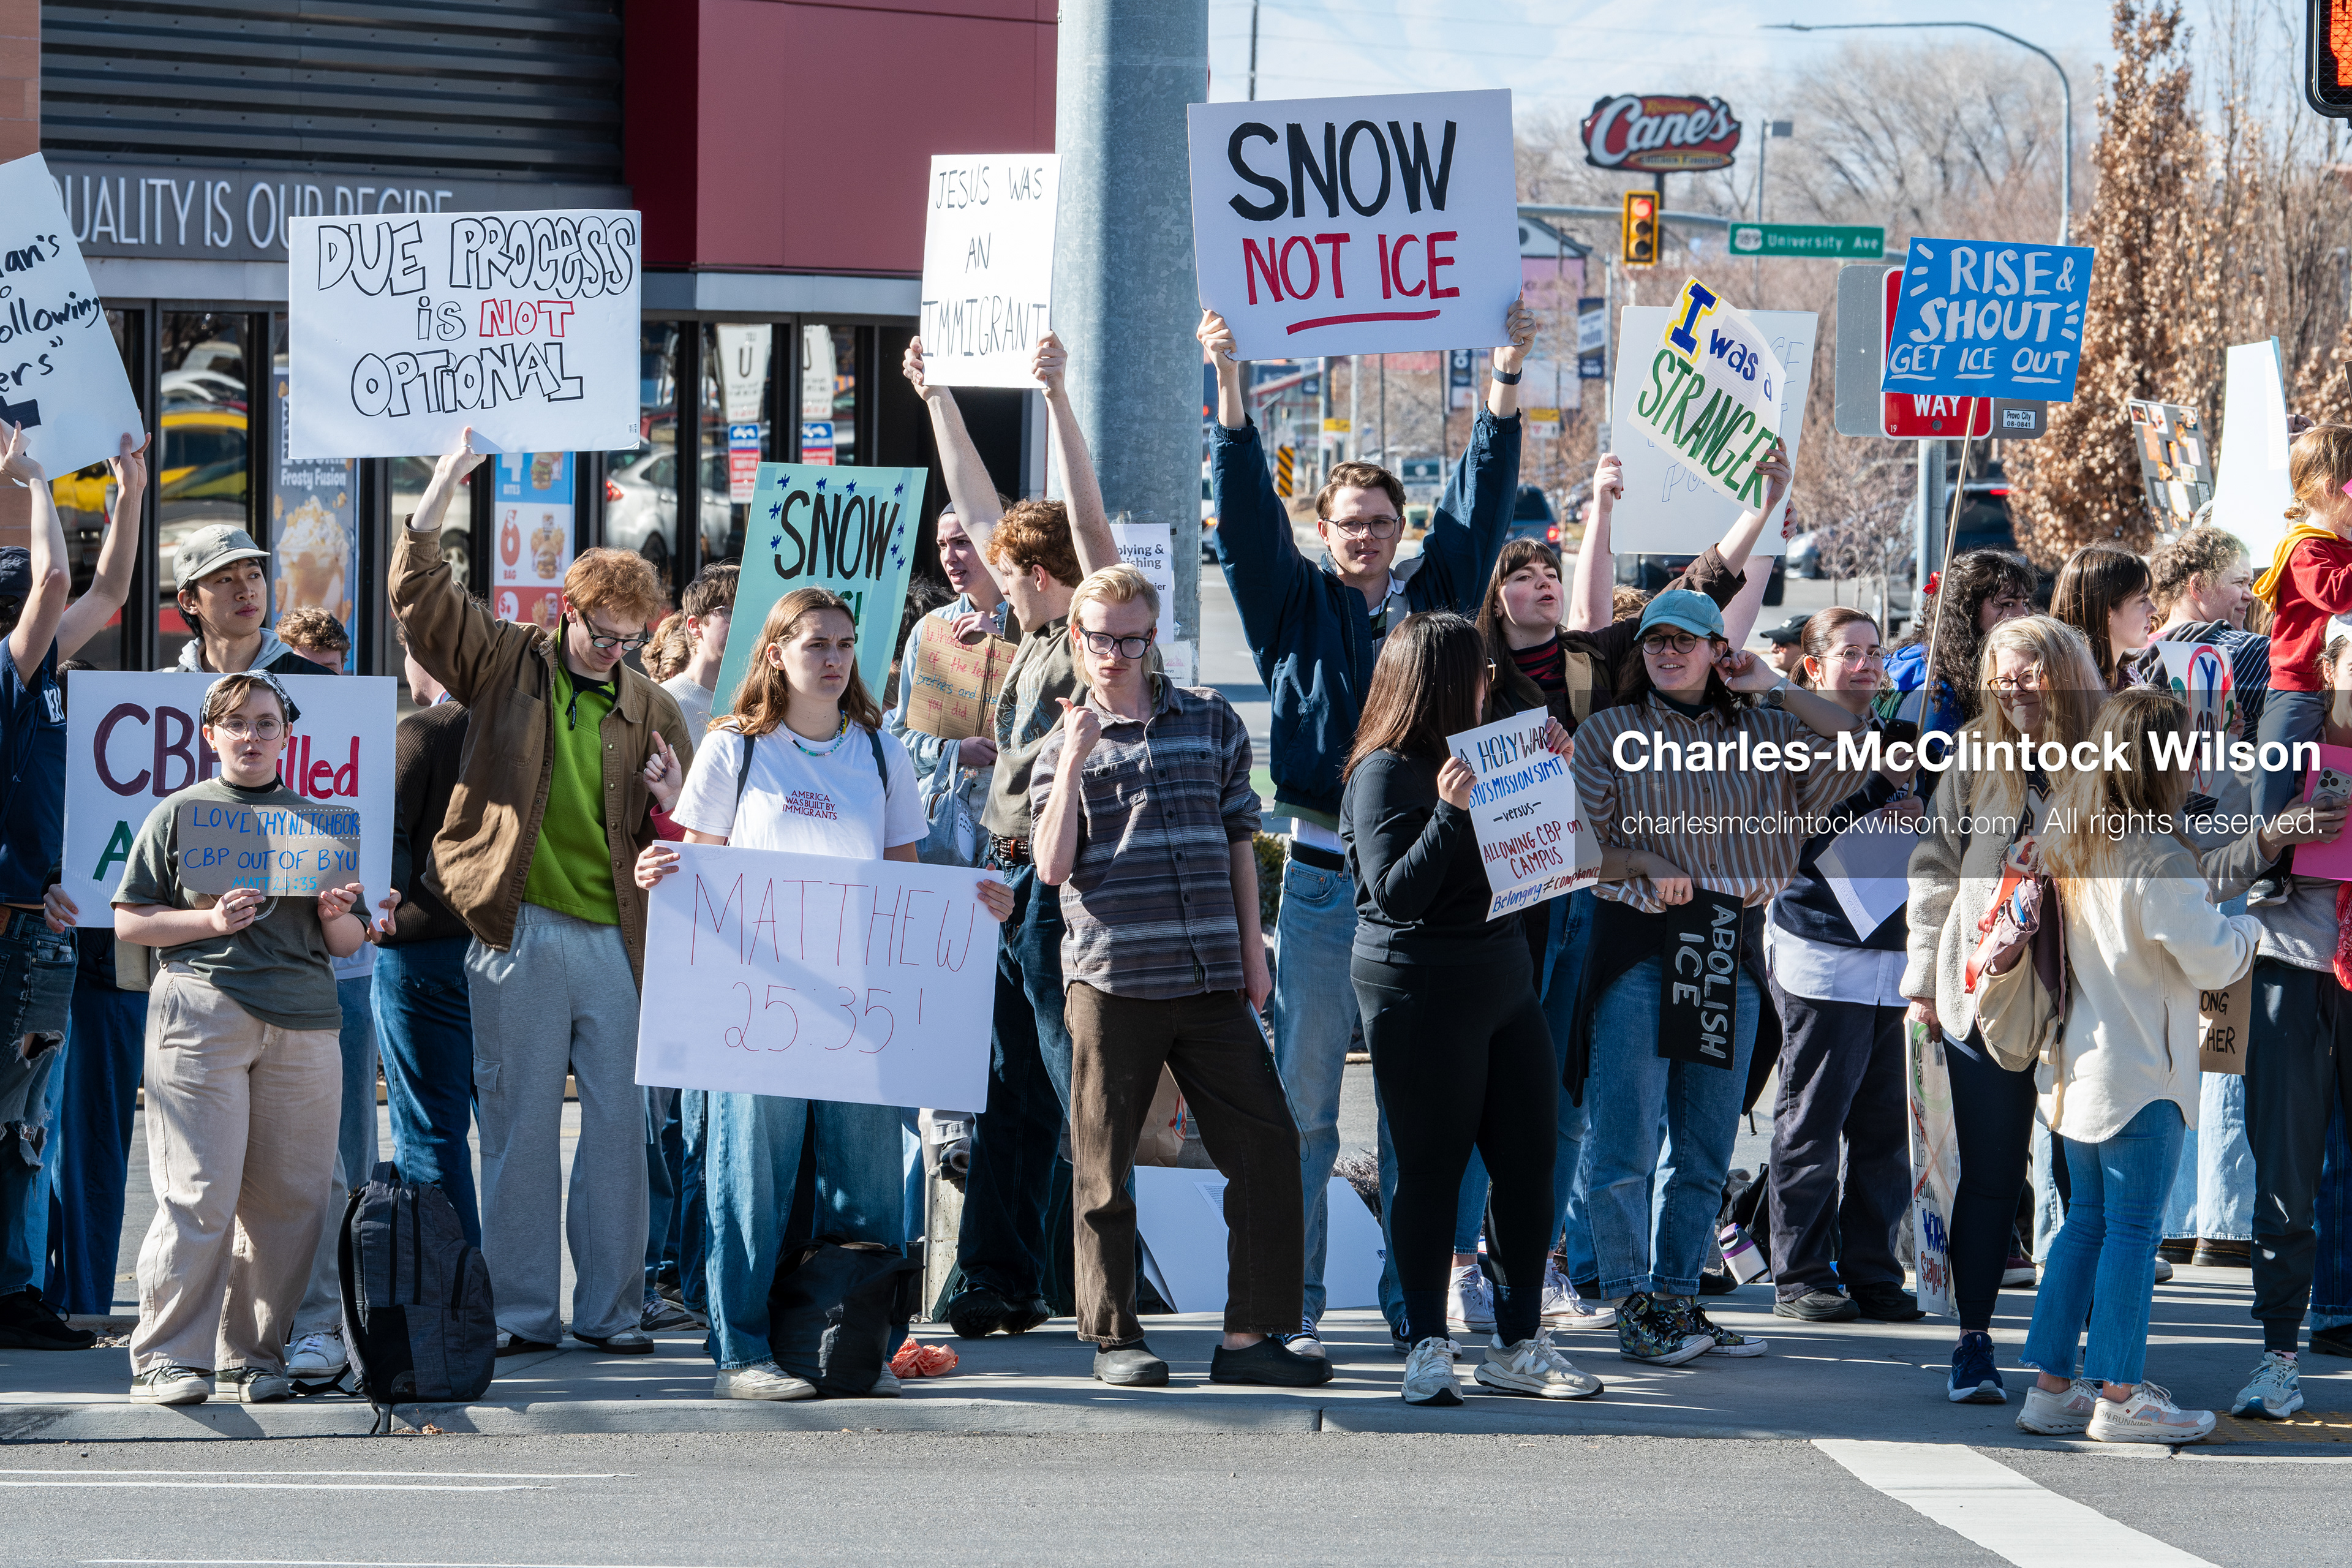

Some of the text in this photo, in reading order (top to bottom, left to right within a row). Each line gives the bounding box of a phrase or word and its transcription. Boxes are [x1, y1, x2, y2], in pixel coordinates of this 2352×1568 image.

[1589, 95, 1739, 166] Cane's
[936, 164, 1043, 209] JESUS WAS
[1228, 119, 1457, 221] SNOW
[50, 174, 195, 245] UALITY
[204, 181, 233, 247] IS
[317, 216, 635, 300] DUE PROCESS
[965, 232, 991, 273] AN
[1767, 233, 1844, 253] University
[1853, 235, 1879, 251] Ave
[1242, 230, 1460, 305] NOT ICE
[1949, 246, 2076, 297] RISE &
[479, 298, 575, 337] NOT
[922, 295, 1047, 357] IMMIGRANT
[1909, 296, 2063, 343] SHOUT
[1670, 282, 1717, 356] I
[1709, 328, 1758, 381] was
[1763, 372, 1772, 402] a
[1890, 344, 2071, 375] GET ICE OUT
[1913, 394, 1960, 417] WAY
[2007, 410, 2032, 421] Provo City
[1637, 348, 1778, 509] STRANGER
[1890, 424, 1898, 433] 19
[281, 467, 347, 489] Frosty Fusion
[774, 489, 901, 581] SNOW
[1155, 543, 1164, 554] &
[928, 651, 940, 673] of
[951, 656, 967, 673] the
[951, 701, 967, 720] did
[958, 685, 978, 701] and
[1477, 732, 1518, 774] HOLY
[1518, 725, 1549, 759] WAR
[1493, 765, 1535, 795] MISSION
[1533, 755, 1563, 783] STMT
[782, 804, 837, 820] IMMIGRANTS
[785, 796, 835, 812] WAS BUILT BY
[791, 790, 831, 802] AMERICA
[194, 806, 360, 836] LOVE THY NEIGHBOR
[184, 847, 357, 872] CBP OUT OF BYU
[1482, 818, 1584, 864] ALLOWING CBP on
[1509, 845, 1564, 880] CAMPUS
[231, 875, 317, 892] MATT 25:35
[1492, 882, 1543, 913] Belonging
[690, 873, 975, 973] MATTHEW
[1673, 932, 1705, 1008] ICE
[1699, 903, 1737, 1060] ABOLISH
[2098, 1409, 2111, 1420] ON
